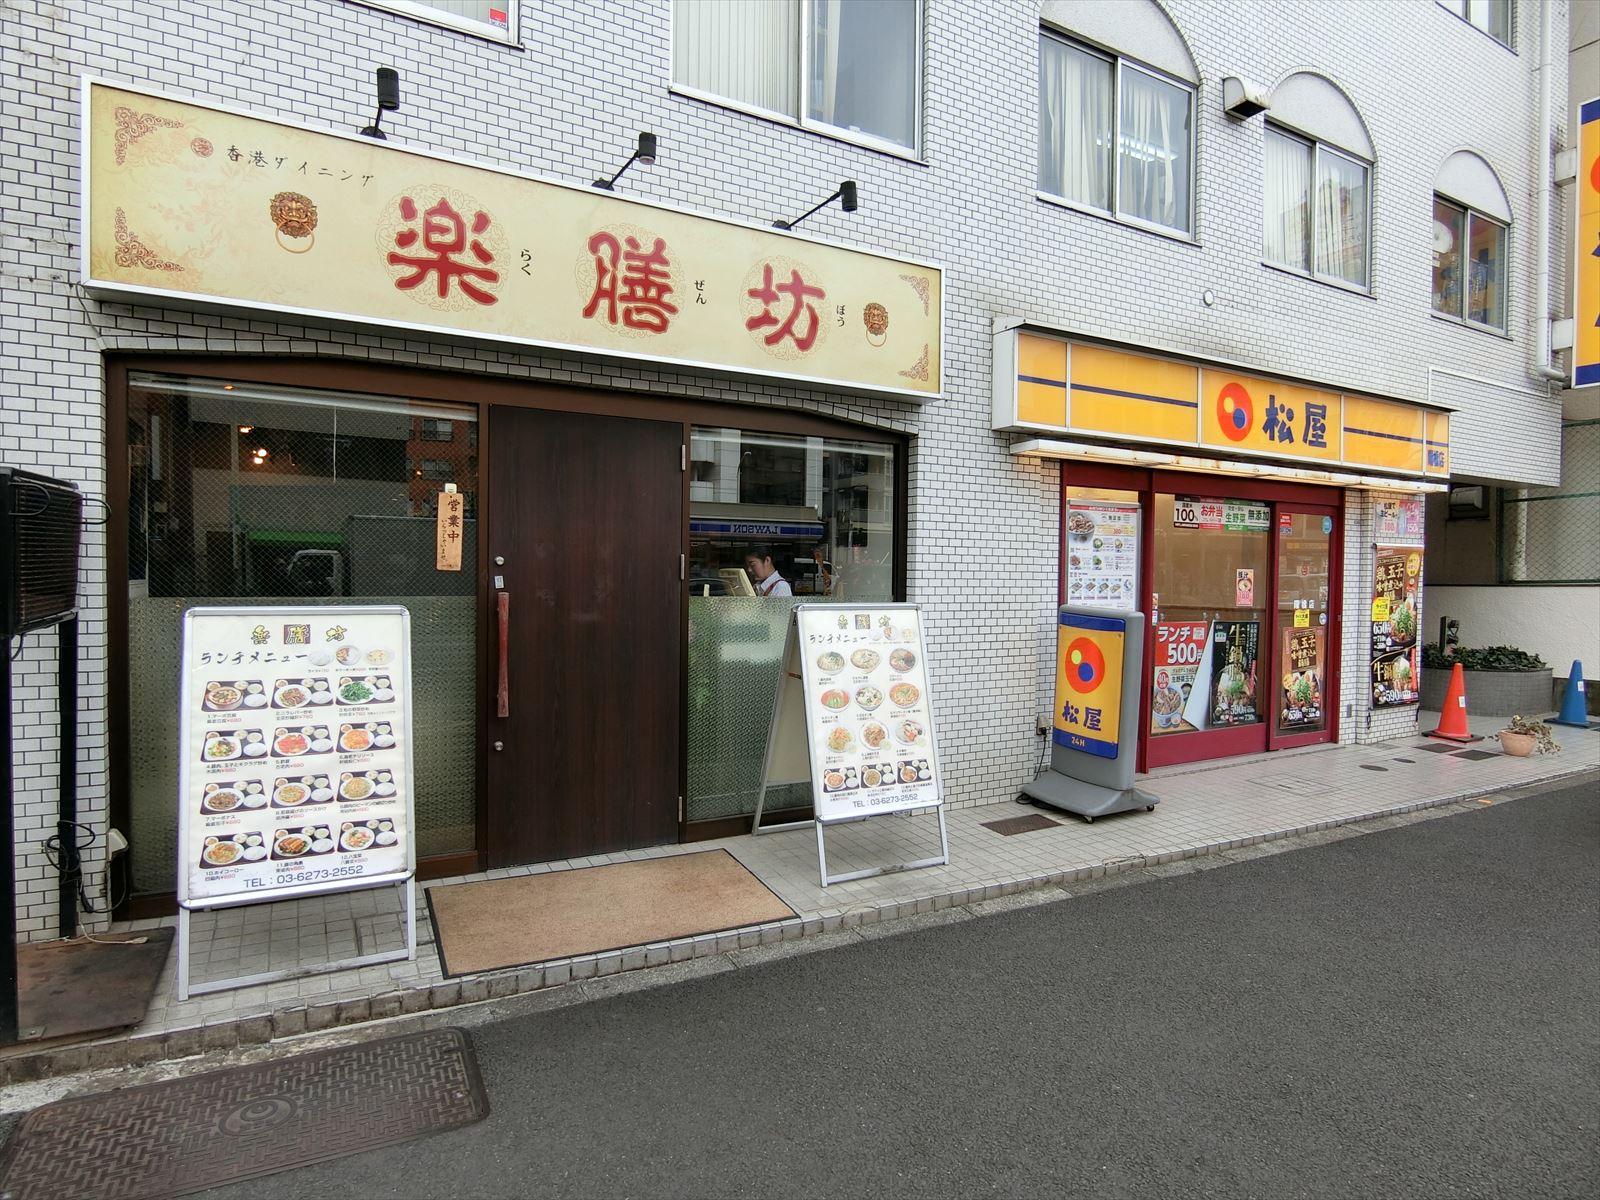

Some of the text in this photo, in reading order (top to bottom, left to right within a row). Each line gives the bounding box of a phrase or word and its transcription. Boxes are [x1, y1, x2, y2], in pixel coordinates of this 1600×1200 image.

[227, 145, 374, 187] 香港ダイニング
[385, 194, 827, 351] 楽膳坊
[519, 248, 532, 276] らく
[694, 279, 707, 305] ぜん
[836, 304, 846, 327] ぼう
[1262, 394, 1327, 448] 松屋
[447, 499, 460, 544] 営業中
[1200, 504, 1223, 518] お弁当
[1247, 509, 1269, 522] 無添加
[1158, 625, 1191, 643] ランチ
[201, 651, 308, 665] ランチメニュー
[1061, 700, 1102, 732] 松屋
[1071, 736, 1085, 747] 24H
[870, 793, 918, 806] 03-6273-2552
[276, 865, 364, 885] 03-6273-2552
